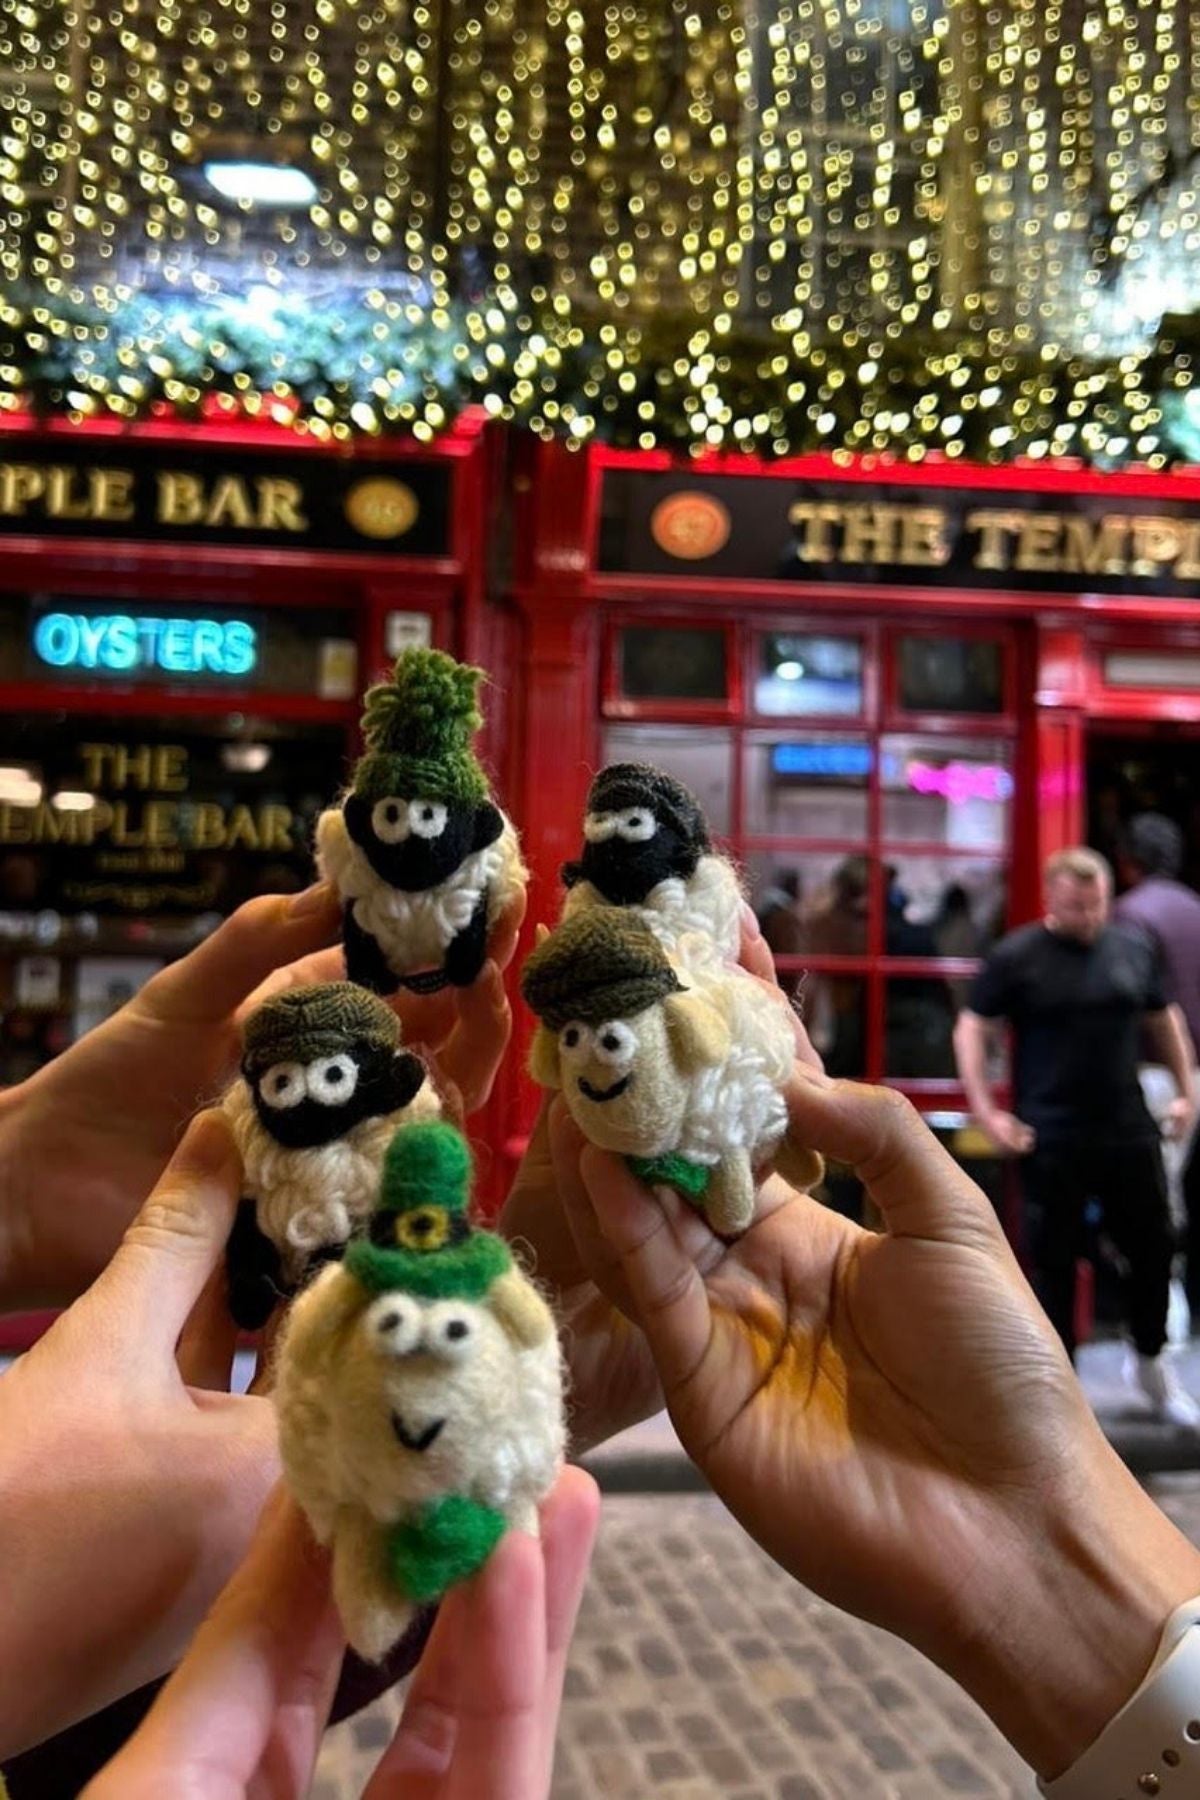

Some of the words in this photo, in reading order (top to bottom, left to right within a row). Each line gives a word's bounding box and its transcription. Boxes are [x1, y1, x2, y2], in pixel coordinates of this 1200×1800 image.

[0, 463, 135, 521] PLE
[156, 470, 308, 532] BAR
[788, 502, 950, 566] THE
[35, 613, 256, 674] OYSTERS
[80, 742, 189, 791] THE
[194, 802, 293, 849] BAR
